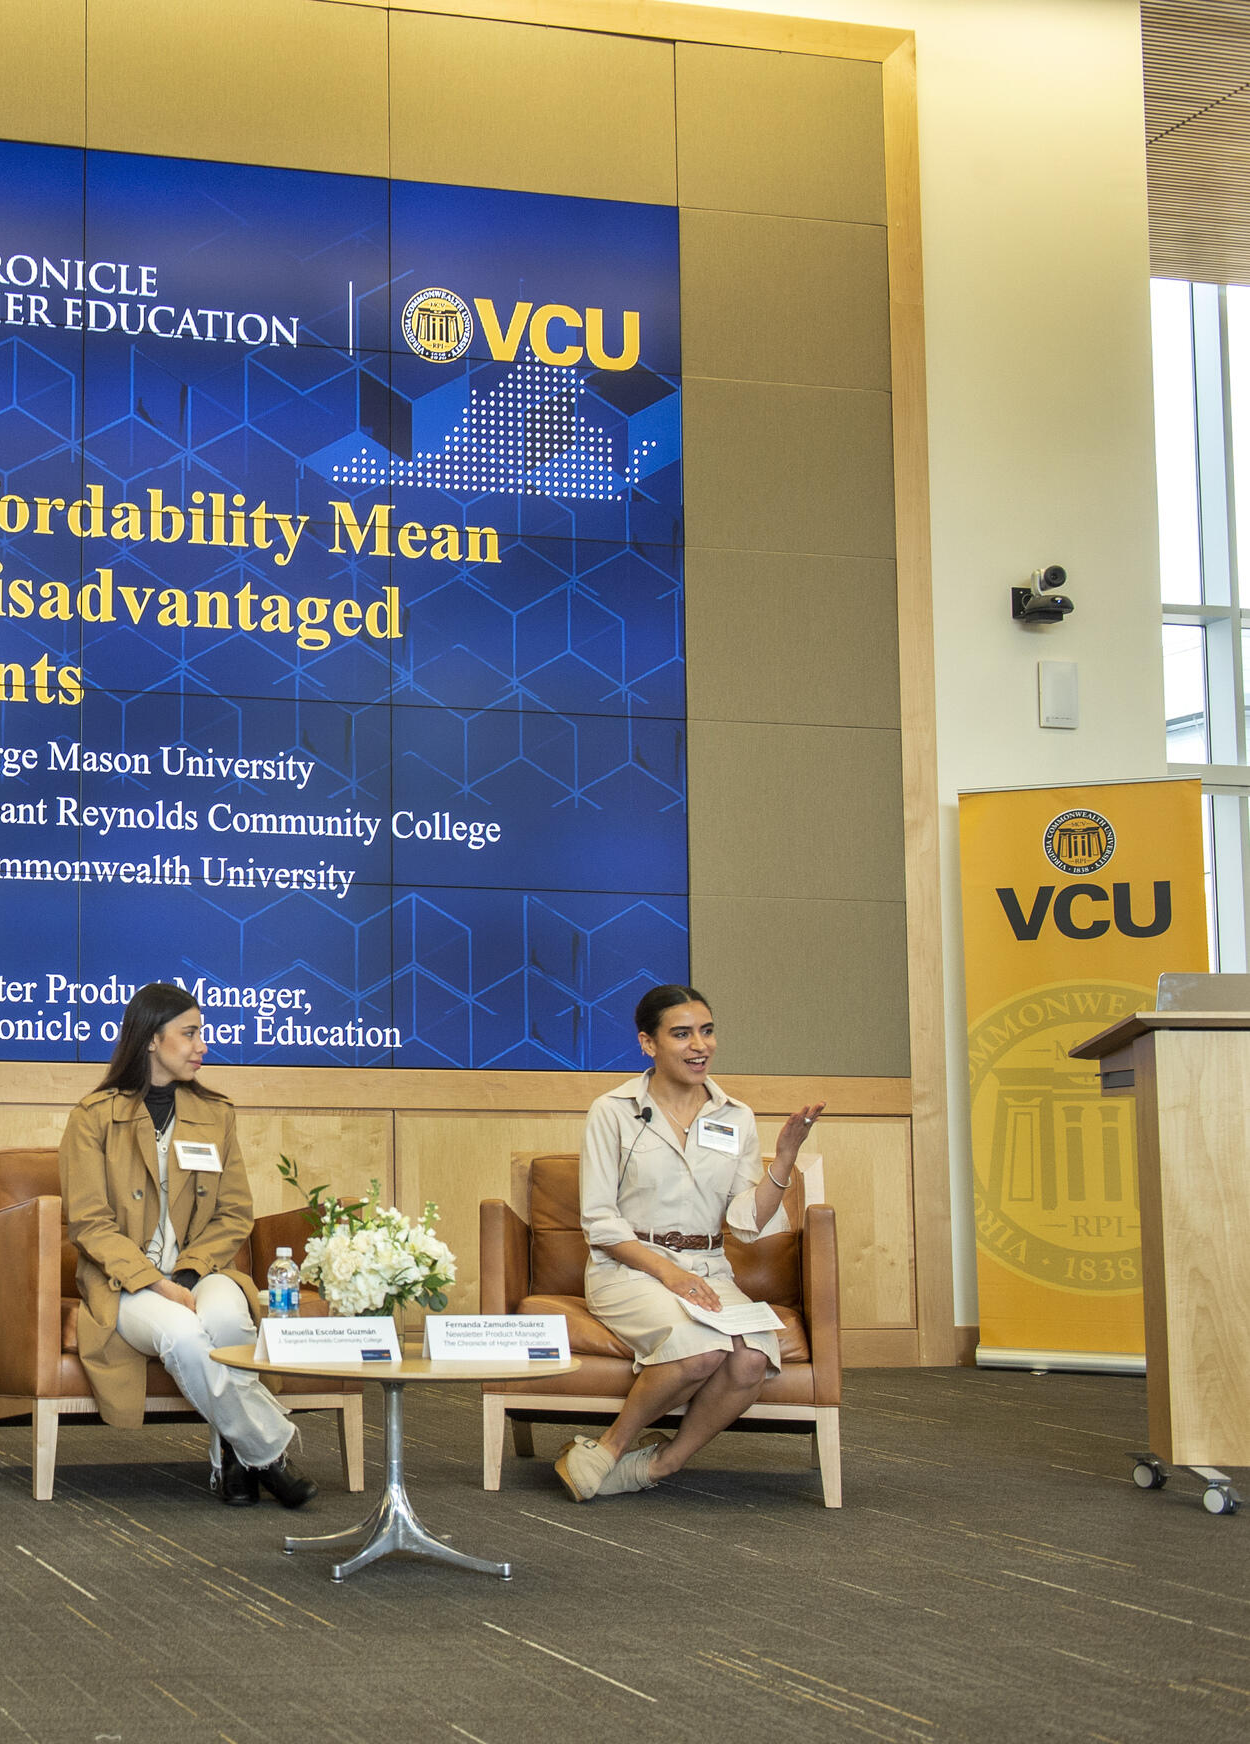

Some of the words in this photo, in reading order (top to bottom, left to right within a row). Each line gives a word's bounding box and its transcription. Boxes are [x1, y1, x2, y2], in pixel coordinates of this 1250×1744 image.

[64, 297, 299, 348] EDUCATION
[473, 297, 640, 372] VCU
[328, 501, 502, 563] Mean
[47, 741, 152, 775] Mason
[160, 746, 315, 790] University
[56, 796, 198, 836] Reynolds
[208, 803, 382, 845] Community
[392, 811, 501, 850] College
[1046, 811, 1105, 839] COMMONWEALTH
[1046, 840, 1066, 871] VIRGINIA
[1095, 826, 1114, 868] UNIVERSITY
[201, 856, 356, 898] University
[996, 880, 1172, 941] VCU
[45, 974, 162, 1005] Produ
[253, 1015, 403, 1049] Education
[1071, 1214, 1126, 1238] RPI
[1063, 1255, 1138, 1282] 1838
